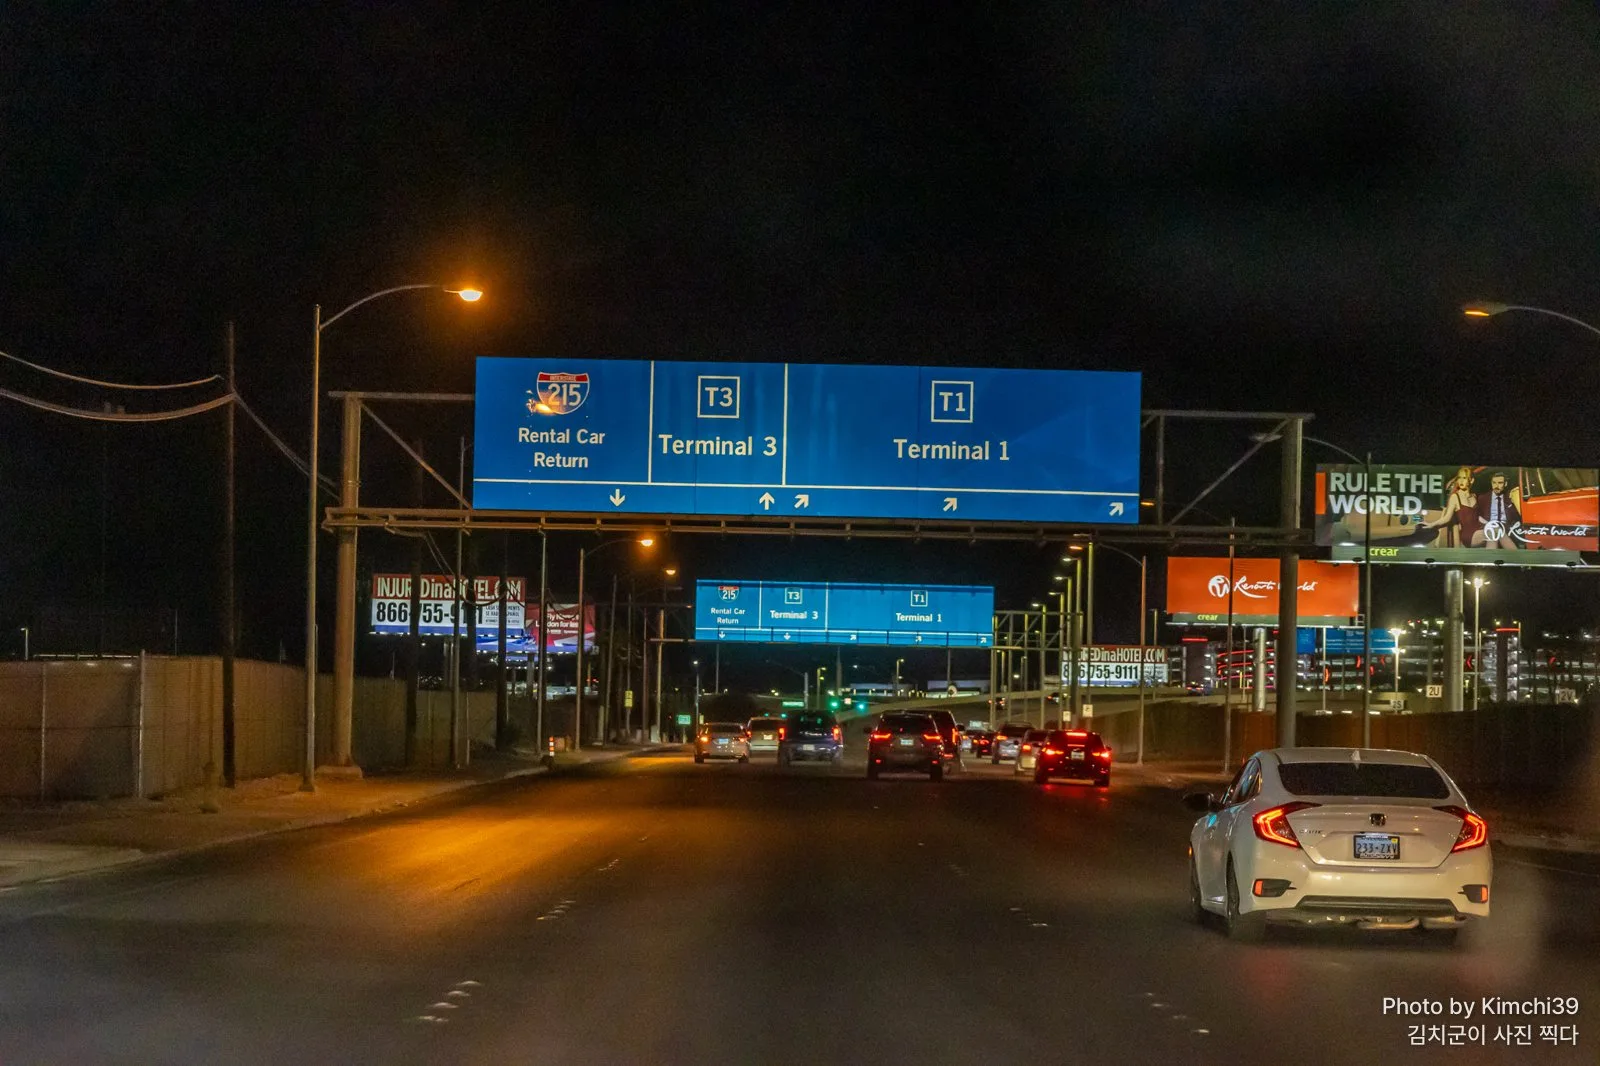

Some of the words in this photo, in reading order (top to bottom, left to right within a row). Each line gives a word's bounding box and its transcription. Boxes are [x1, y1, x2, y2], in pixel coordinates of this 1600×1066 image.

[548, 383, 581, 406] 215
[705, 387, 733, 407] T3
[939, 391, 965, 412] T1
[518, 427, 570, 444] Rental
[576, 428, 606, 444] Car
[658, 434, 753, 456] Terminal
[763, 436, 777, 456] 3
[893, 438, 990, 460] Terminal
[999, 440, 1010, 461] 1
[533, 452, 589, 468] Return
[1330, 472, 1391, 493] RULE
[1394, 473, 1443, 494] THE
[1328, 494, 1428, 516] WORLD.
[1369, 547, 1399, 557] crear
[722, 590, 736, 600] 215
[788, 592, 800, 600] T3
[914, 594, 925, 603] T1
[770, 610, 807, 620] Terminal
[812, 611, 818, 620] 3
[896, 612, 933, 622] Terminal
[937, 613, 942, 622] 1
[1197, 613, 1218, 621] crear
[1429, 686, 1440, 696] 2U
